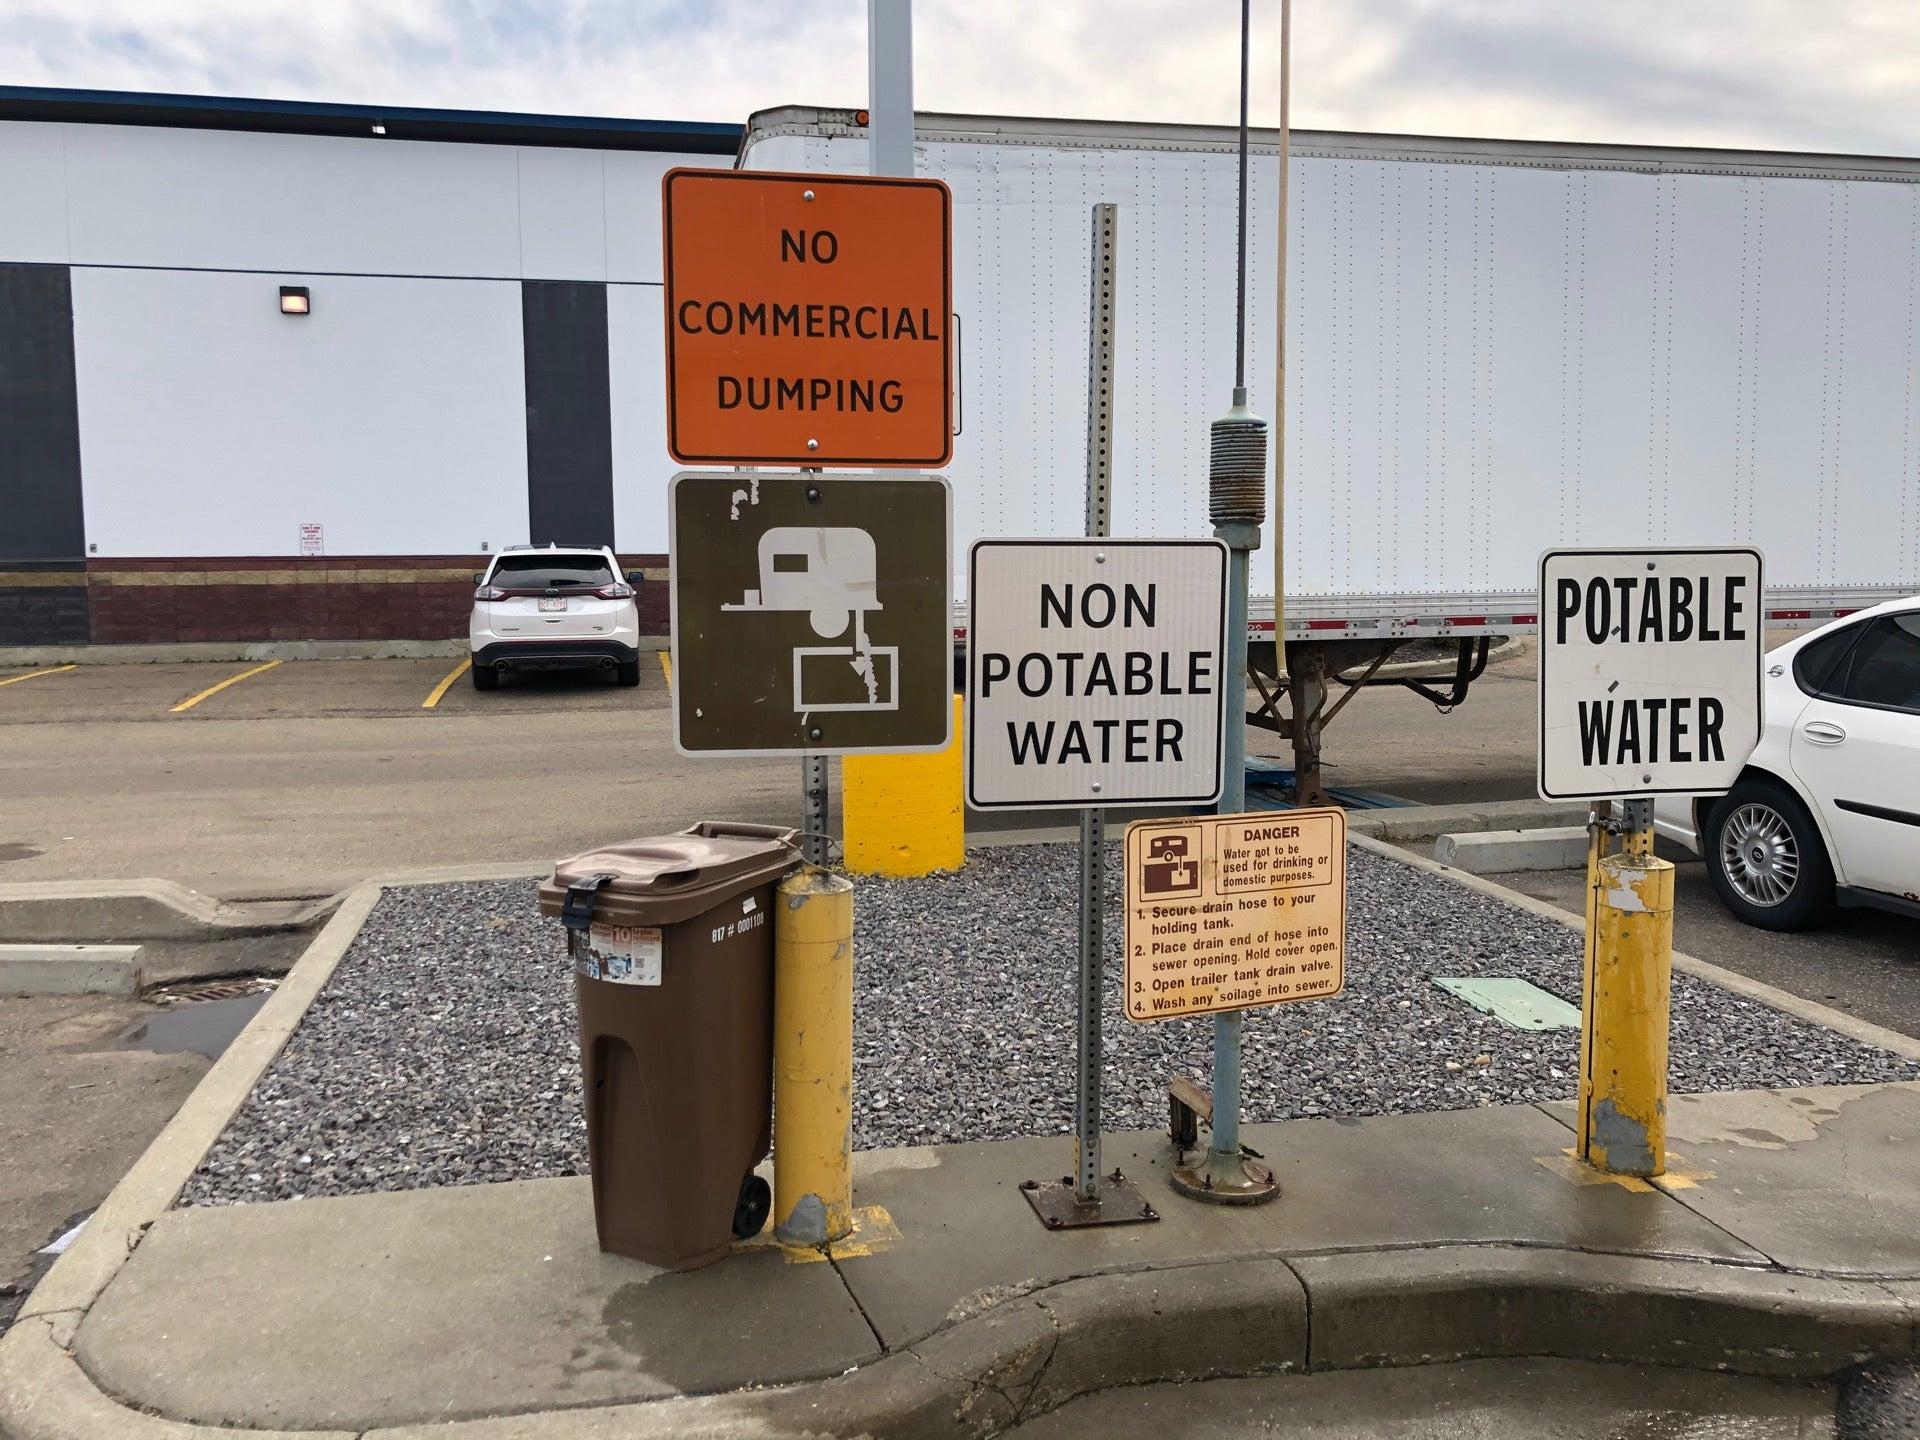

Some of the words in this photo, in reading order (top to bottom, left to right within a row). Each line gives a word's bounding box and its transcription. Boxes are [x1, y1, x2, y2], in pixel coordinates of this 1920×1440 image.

[781, 230, 838, 264] NO
[678, 300, 939, 341] COMMERCIAL
[718, 376, 904, 414] DUMPING
[1040, 583, 1156, 628] NON
[1556, 576, 1746, 644] POTABLE
[981, 651, 1212, 697] POTABLE
[1006, 719, 1184, 765] WATER
[1578, 697, 1725, 767] WATER
[1244, 826, 1300, 841] DANGER
[1223, 849, 1250, 860] Water
[1255, 847, 1270, 857] not
[1275, 846, 1284, 855] to
[1288, 844, 1299, 854] be
[1223, 861, 1248, 873] used
[1253, 860, 1267, 871] for
[1272, 856, 1313, 869] drinking
[1318, 855, 1329, 865] or
[1223, 874, 1266, 887] domestic
[1270, 871, 1315, 885] purposes.
[1136, 909, 1146, 920] 1.
[1152, 905, 1197, 919] Secure
[1203, 902, 1233, 914] drain
[1238, 898, 1267, 910] hose
[1273, 896, 1285, 907] to
[1290, 893, 1316, 907] your
[613, 927, 631, 942] 10
[712, 927, 725, 943] 817
[1135, 945, 1146, 956] 2.
[1151, 942, 1187, 955] Place
[1193, 938, 1224, 951] drain
[1229, 934, 1251, 947] end
[1257, 931, 1269, 944] of
[1274, 929, 1302, 941] hose
[1307, 926, 1329, 938] into
[1151, 919, 1197, 935] holding
[1203, 917, 1234, 930] tank.
[1152, 959, 1187, 971] sewer
[1193, 953, 1240, 968] opening.
[1245, 949, 1270, 961] Hold
[1275, 945, 1305, 956] cover
[1310, 941, 1338, 955] open.
[1134, 981, 1146, 993] 3.
[1152, 978, 1185, 992] Open
[1191, 971, 1228, 986] trailer
[1234, 968, 1260, 980] tank
[1266, 963, 1295, 977] drain
[1301, 960, 1333, 973] valve.
[1134, 1001, 1146, 1013] 4.
[1153, 995, 1186, 1010] Wash
[1192, 992, 1213, 1006] any
[1220, 986, 1262, 1002] soilage
[1267, 983, 1289, 995] into
[1295, 979, 1333, 991] sewer.
